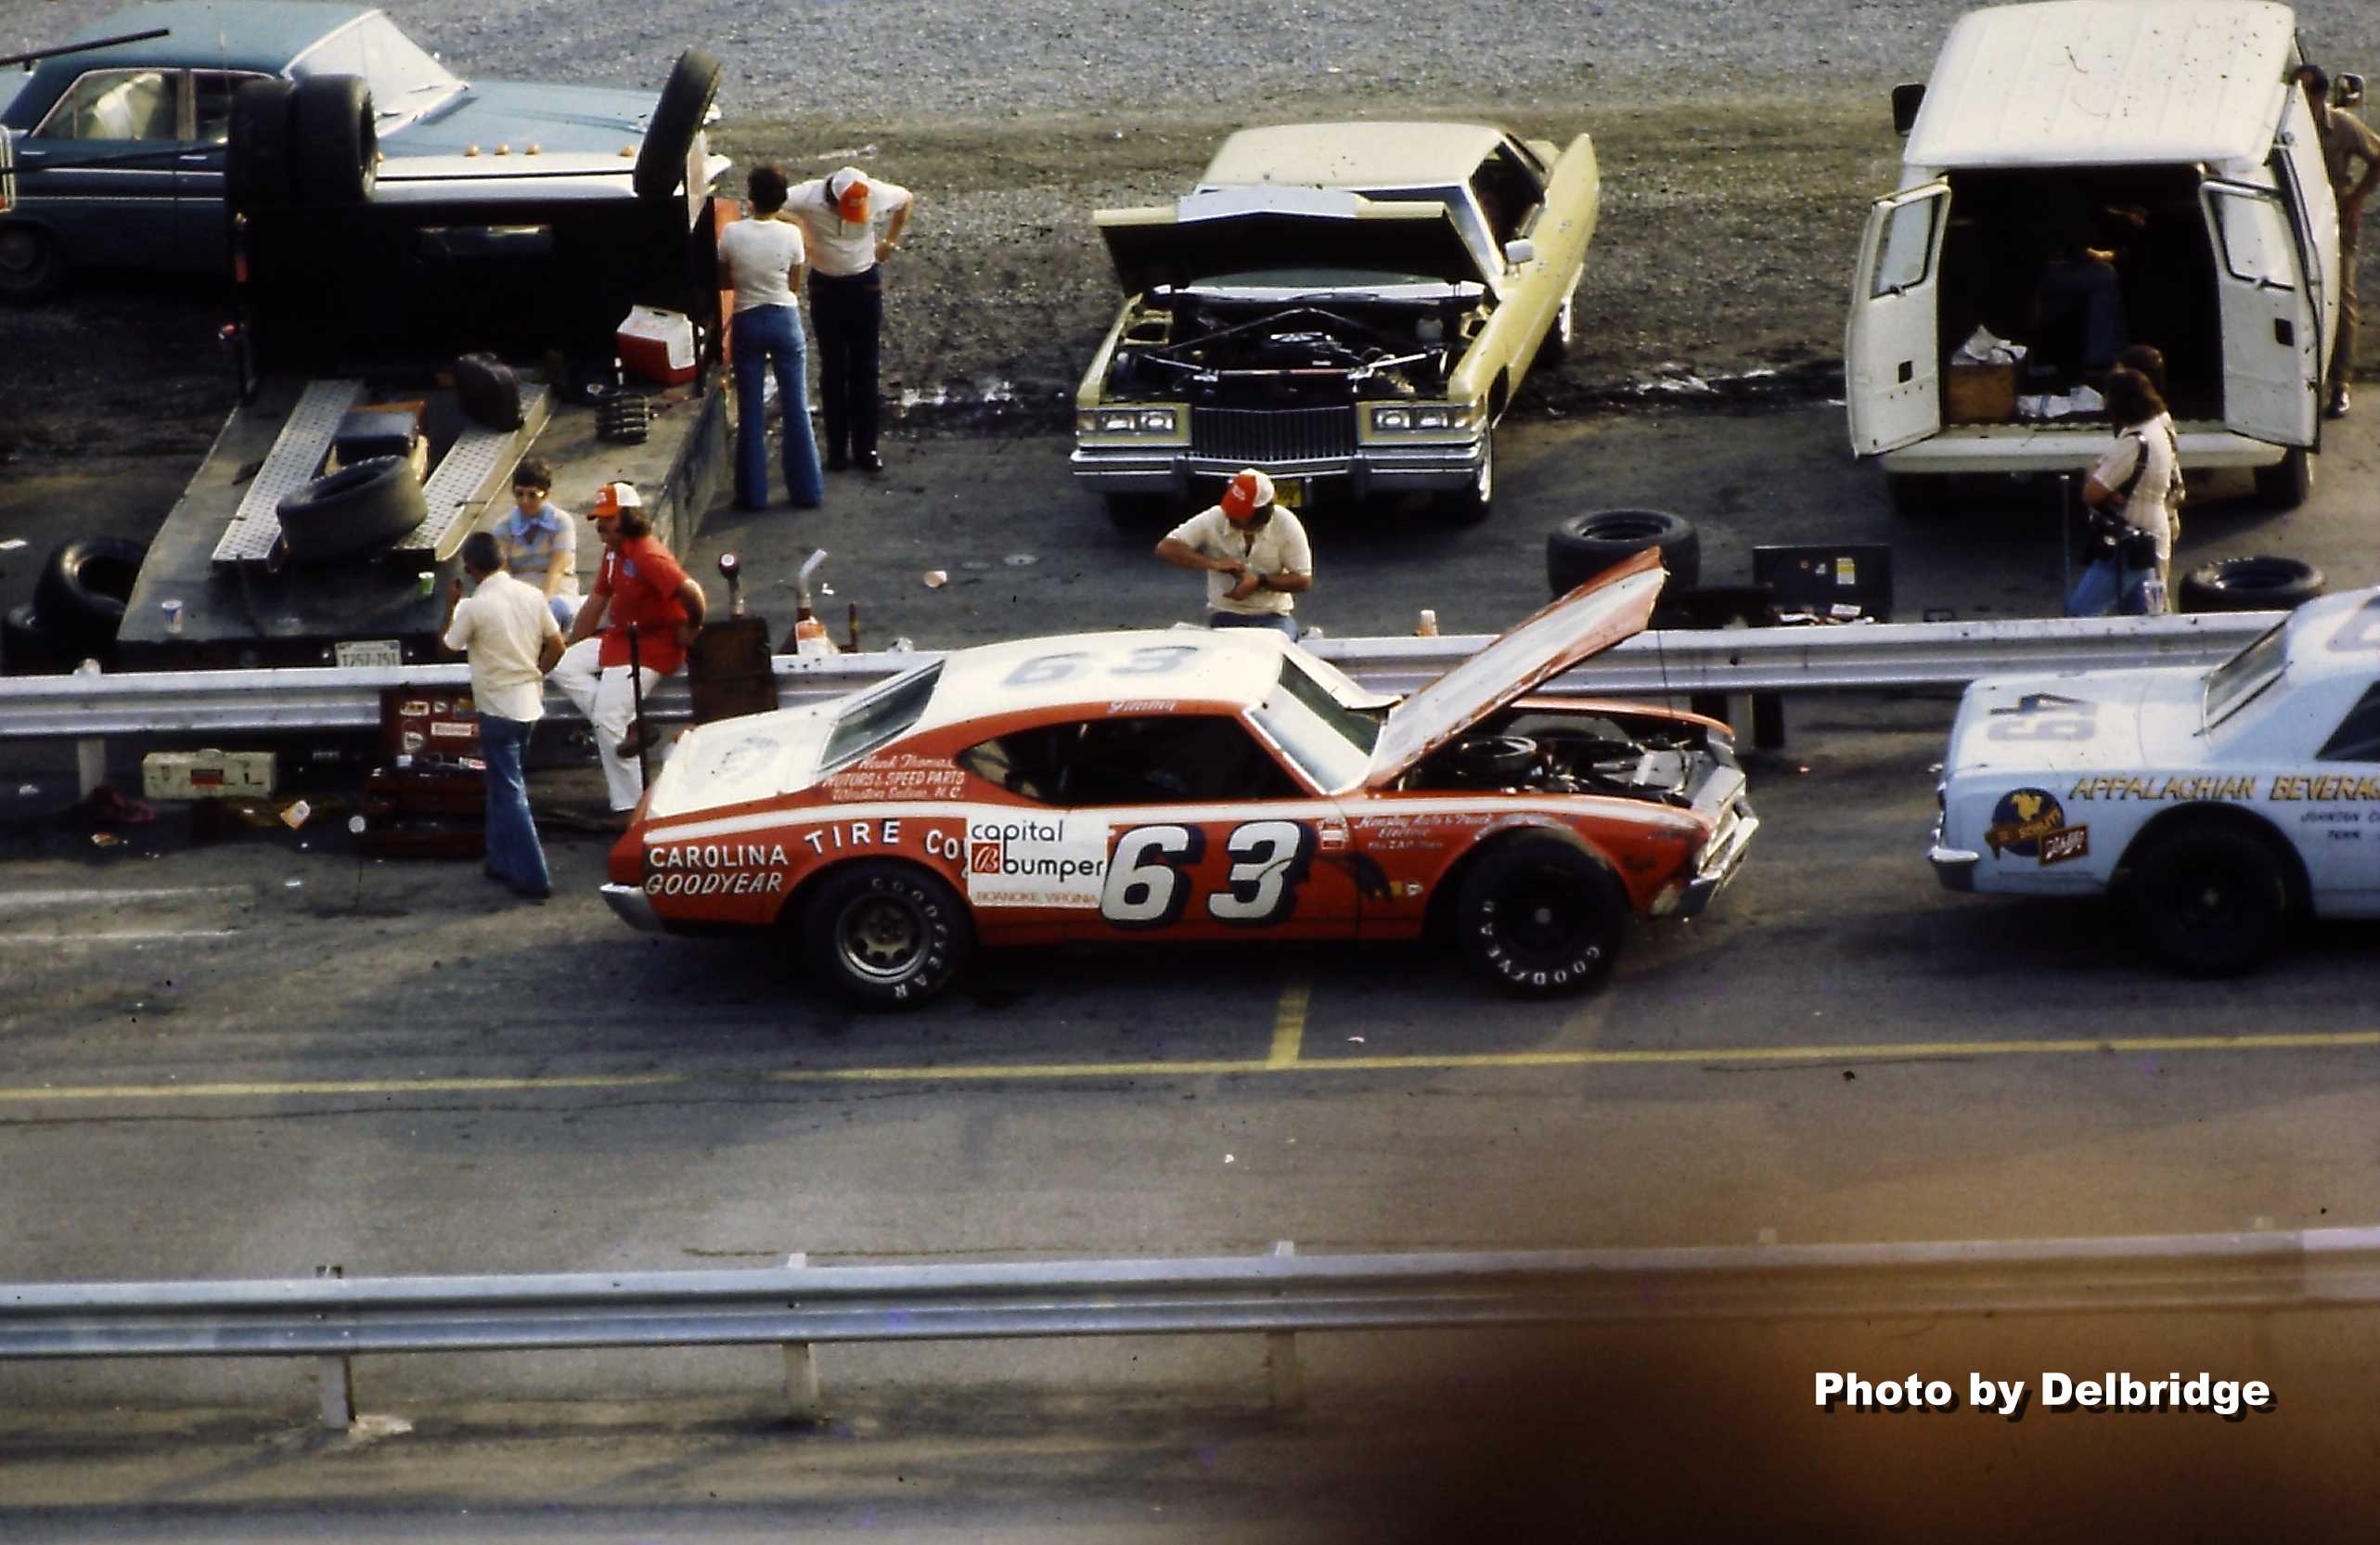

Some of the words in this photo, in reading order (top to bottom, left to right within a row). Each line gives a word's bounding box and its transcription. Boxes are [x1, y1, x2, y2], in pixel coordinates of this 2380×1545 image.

[1006, 645, 1200, 687] 63
[886, 771, 925, 786] SPEED
[927, 770, 966, 785] PARTS
[2067, 775, 2257, 802] APPALACHIAN
[650, 843, 789, 869] CAROLINA
[804, 820, 902, 856] TIRE
[971, 818, 1064, 857] capital
[1002, 844, 1105, 882] bumper
[1100, 820, 1308, 925] 63
[645, 871, 783, 896] GOODYEAR
